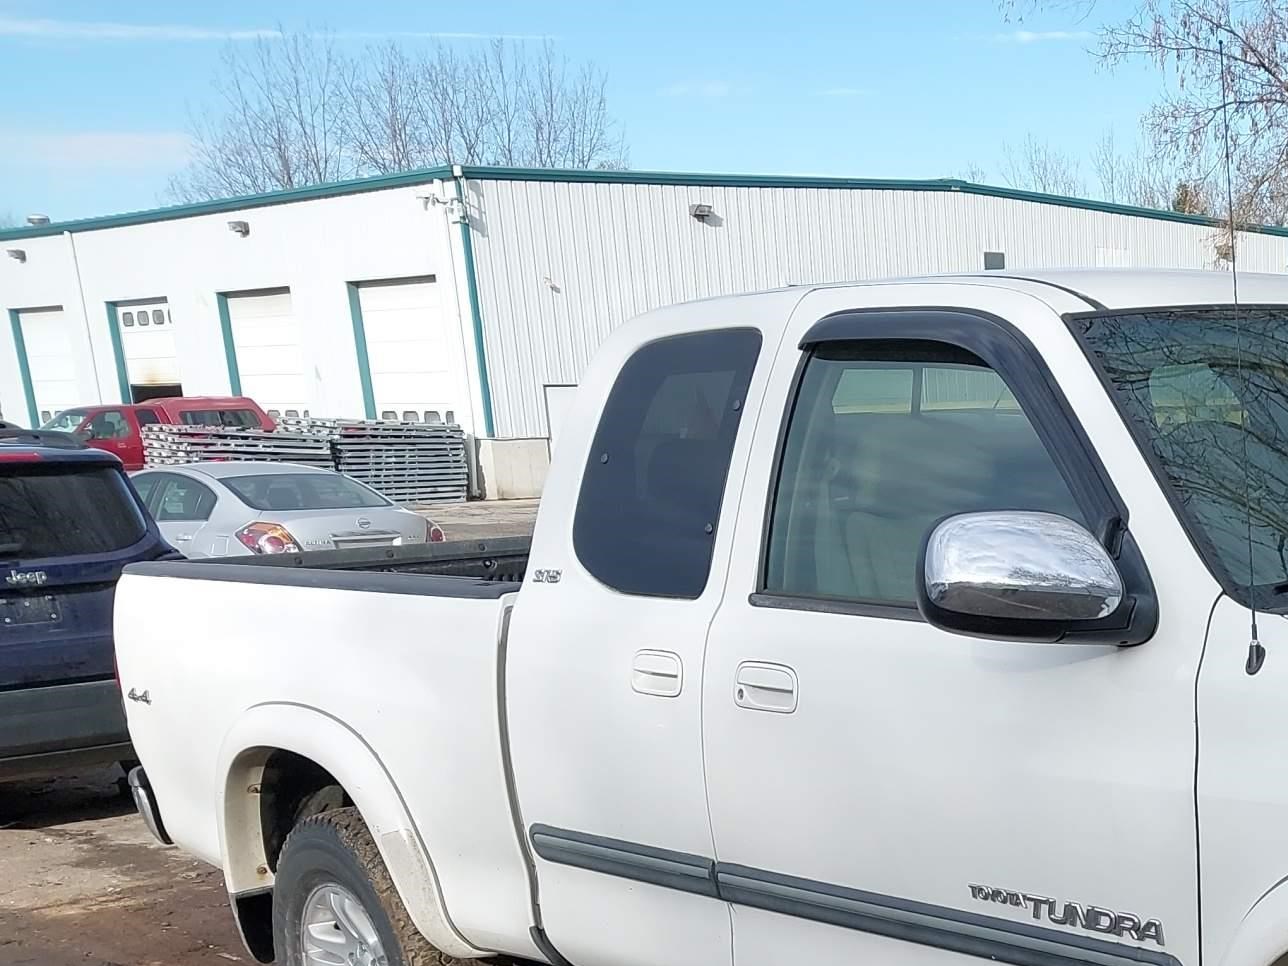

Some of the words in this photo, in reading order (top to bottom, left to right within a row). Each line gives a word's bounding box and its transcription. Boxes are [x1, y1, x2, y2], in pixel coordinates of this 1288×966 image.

[5, 569, 47, 585] Jeep
[967, 883, 1028, 909] TOYOTA
[1026, 893, 1166, 947] TUNDRA
